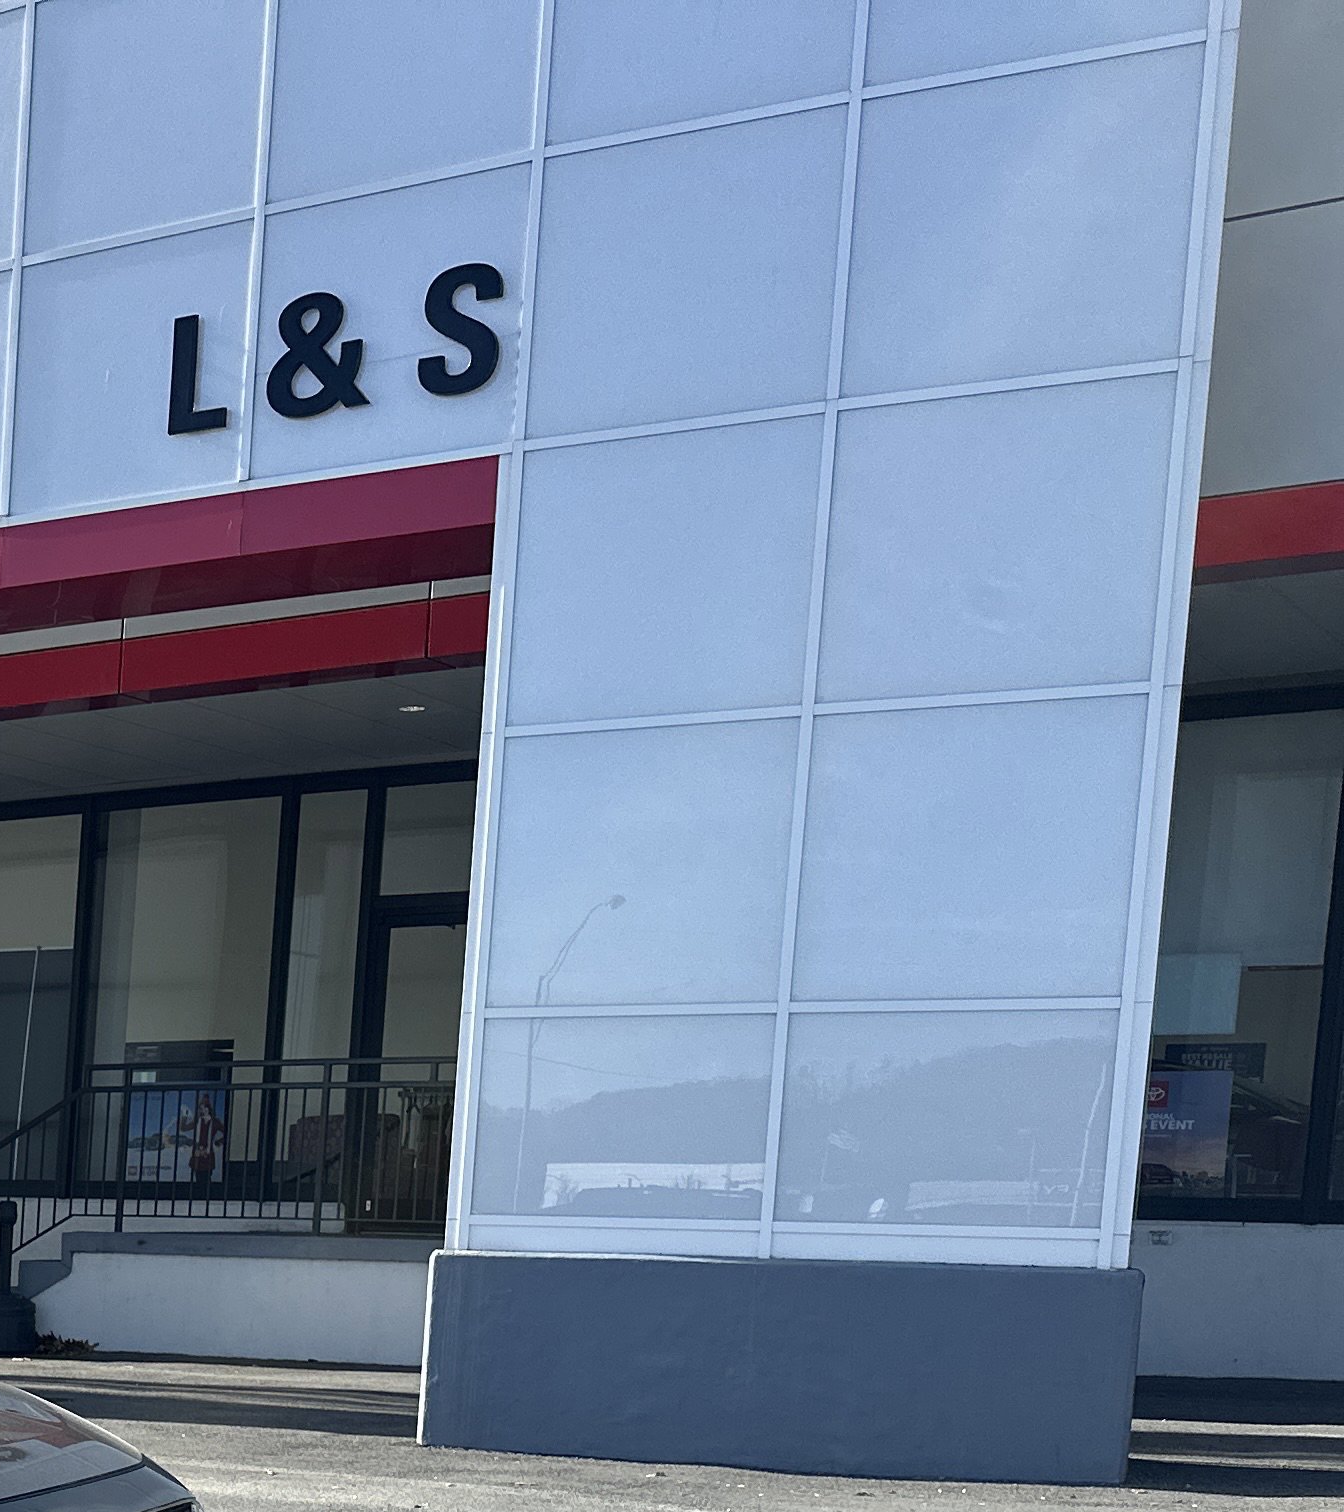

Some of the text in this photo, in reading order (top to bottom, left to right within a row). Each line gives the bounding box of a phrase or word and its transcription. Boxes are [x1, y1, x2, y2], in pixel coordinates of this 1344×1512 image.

[168, 262, 504, 435] L & S
[1150, 1119, 1196, 1130] EVENT
